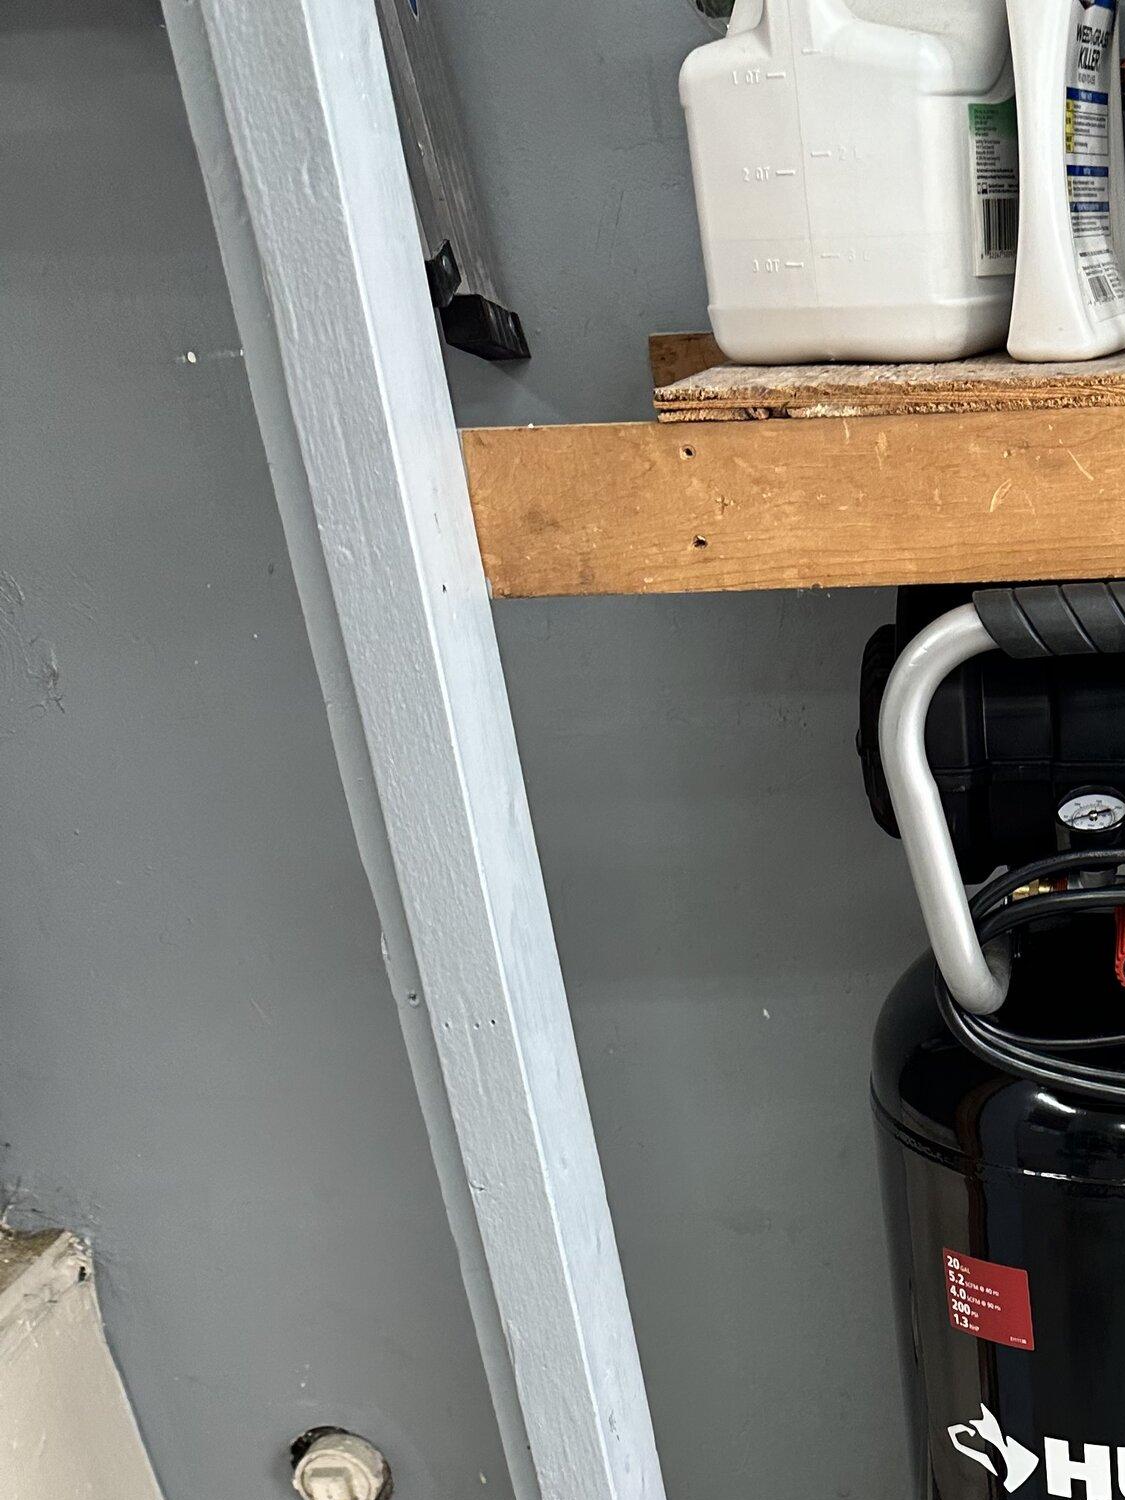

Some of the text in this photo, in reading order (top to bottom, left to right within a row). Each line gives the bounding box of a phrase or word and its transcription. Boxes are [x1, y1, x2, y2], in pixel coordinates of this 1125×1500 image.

[947, 1255, 960, 1270] 20
[948, 1270, 965, 1286] 5.2
[950, 1284, 967, 1300] 4.0
[951, 1299, 971, 1316] 200
[953, 1313, 969, 1328] 1.3
